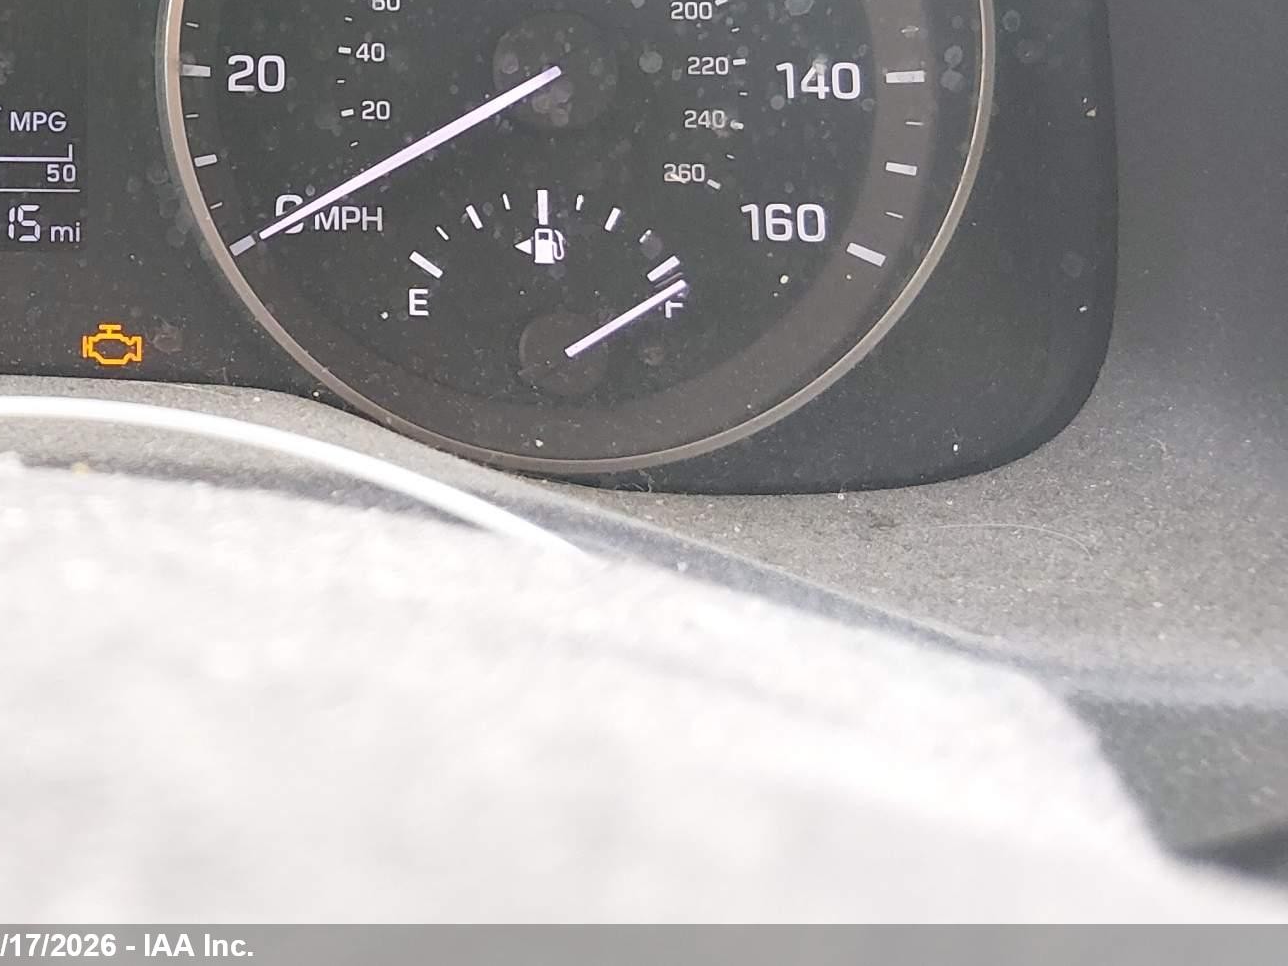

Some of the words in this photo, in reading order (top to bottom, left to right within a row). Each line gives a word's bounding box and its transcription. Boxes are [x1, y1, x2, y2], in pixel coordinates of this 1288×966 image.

[671, 2, 712, 20] 200
[356, 43, 385, 61] 40
[227, 56, 285, 92] 20
[687, 57, 729, 75] 220
[776, 63, 860, 100] 140
[361, 102, 390, 121] 20
[684, 110, 726, 129] 240
[10, 111, 67, 132] MPG
[46, 164, 76, 183] 50
[663, 164, 705, 183] 260
[314, 206, 383, 232] MPH
[740, 204, 825, 242] 160
[50, 222, 81, 242] mi
[409, 289, 428, 316] E
